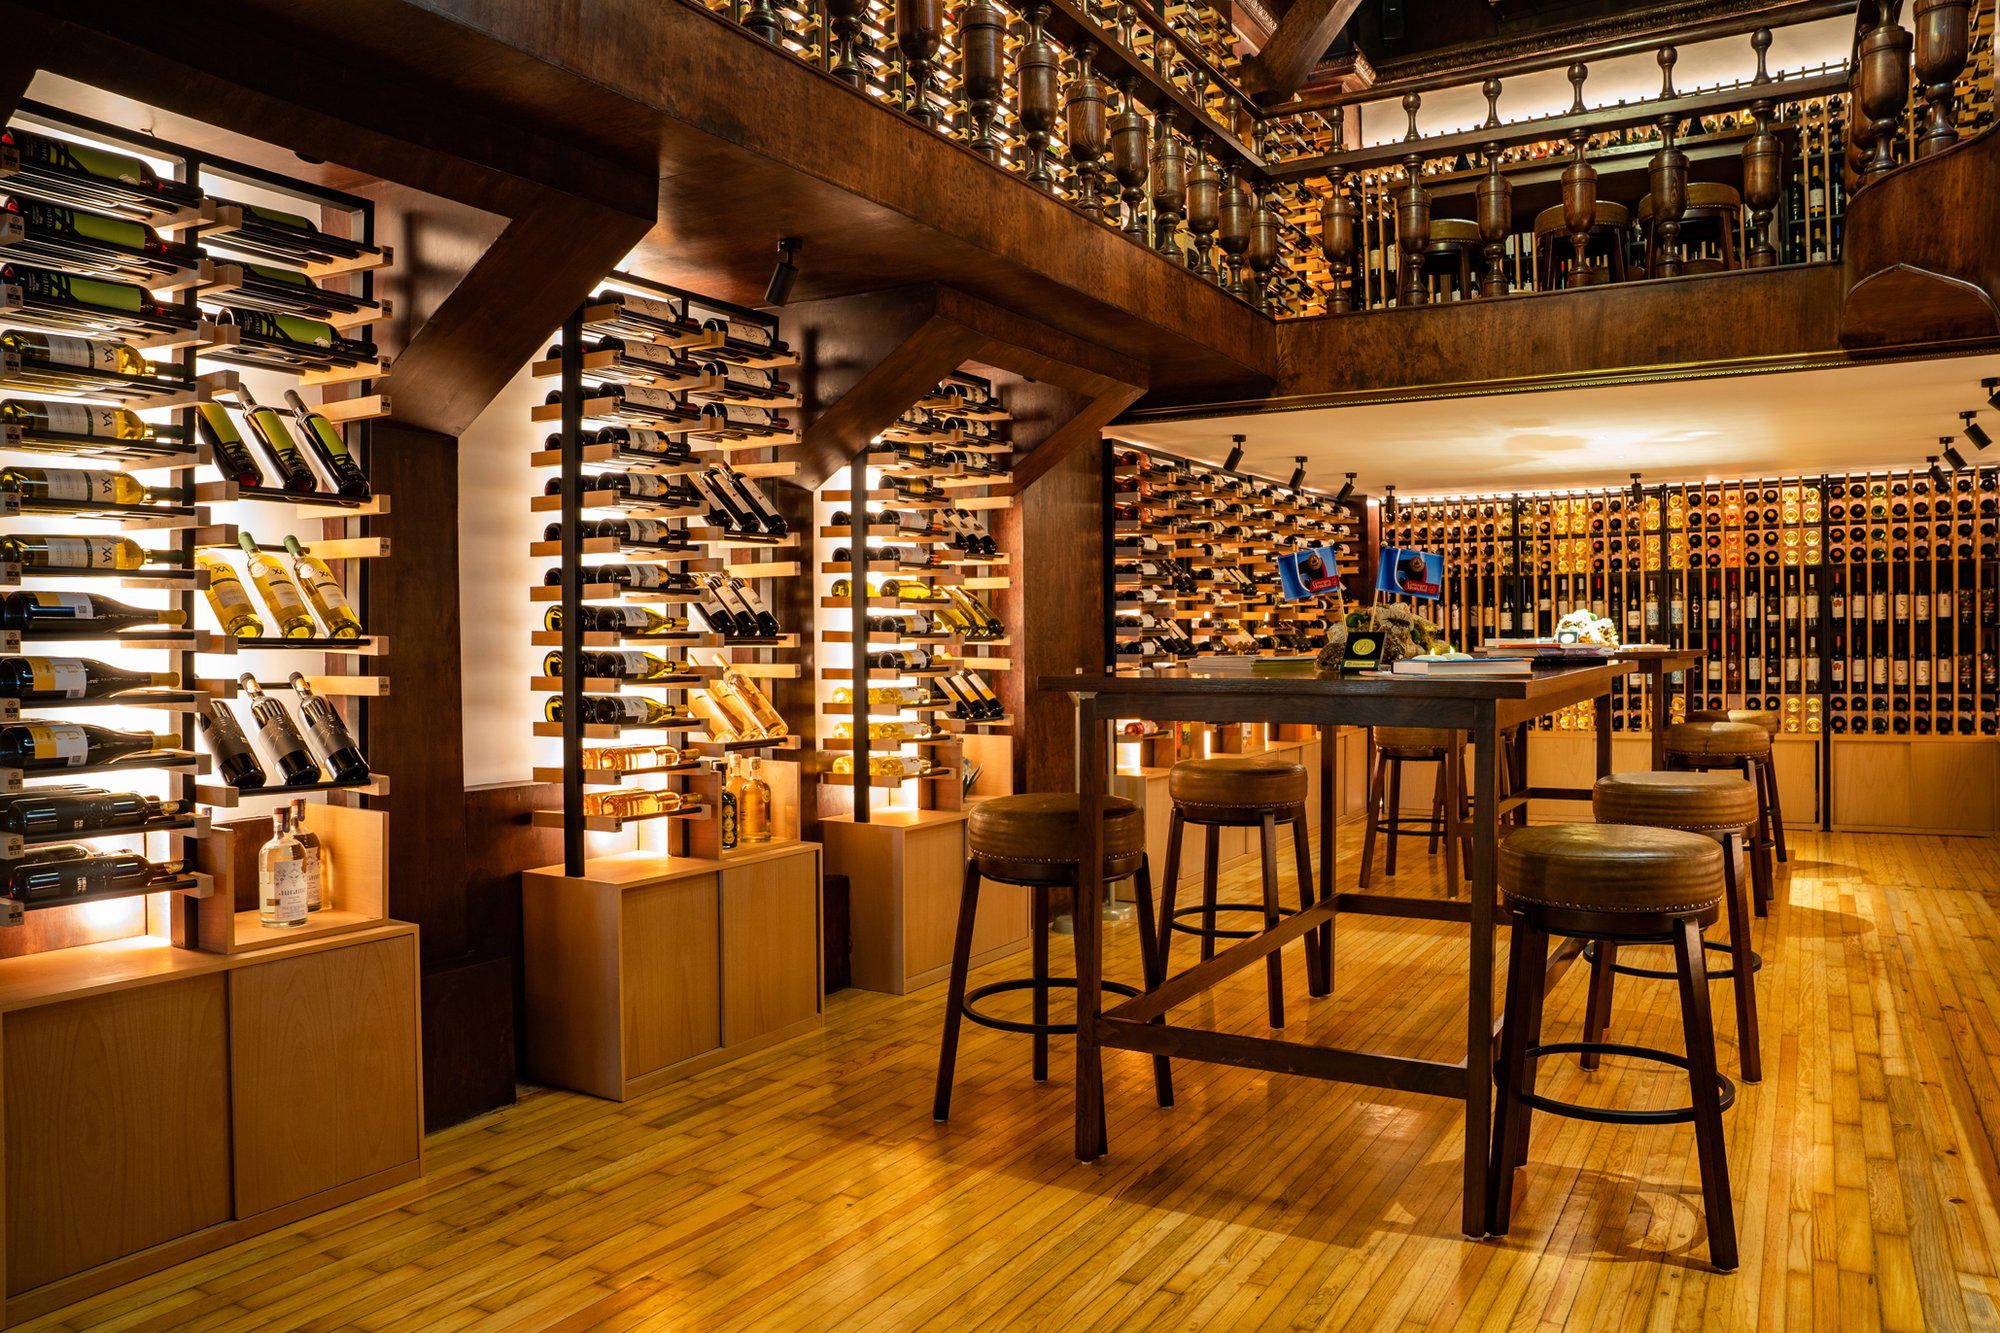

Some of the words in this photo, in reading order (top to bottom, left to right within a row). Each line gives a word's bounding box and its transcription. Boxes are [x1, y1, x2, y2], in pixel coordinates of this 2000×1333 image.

[103, 347, 115, 363] XA
[101, 411, 113, 427] XA
[100, 478, 113, 494] XA
[101, 546, 113, 563] XA
[214, 566, 230, 574] XA
